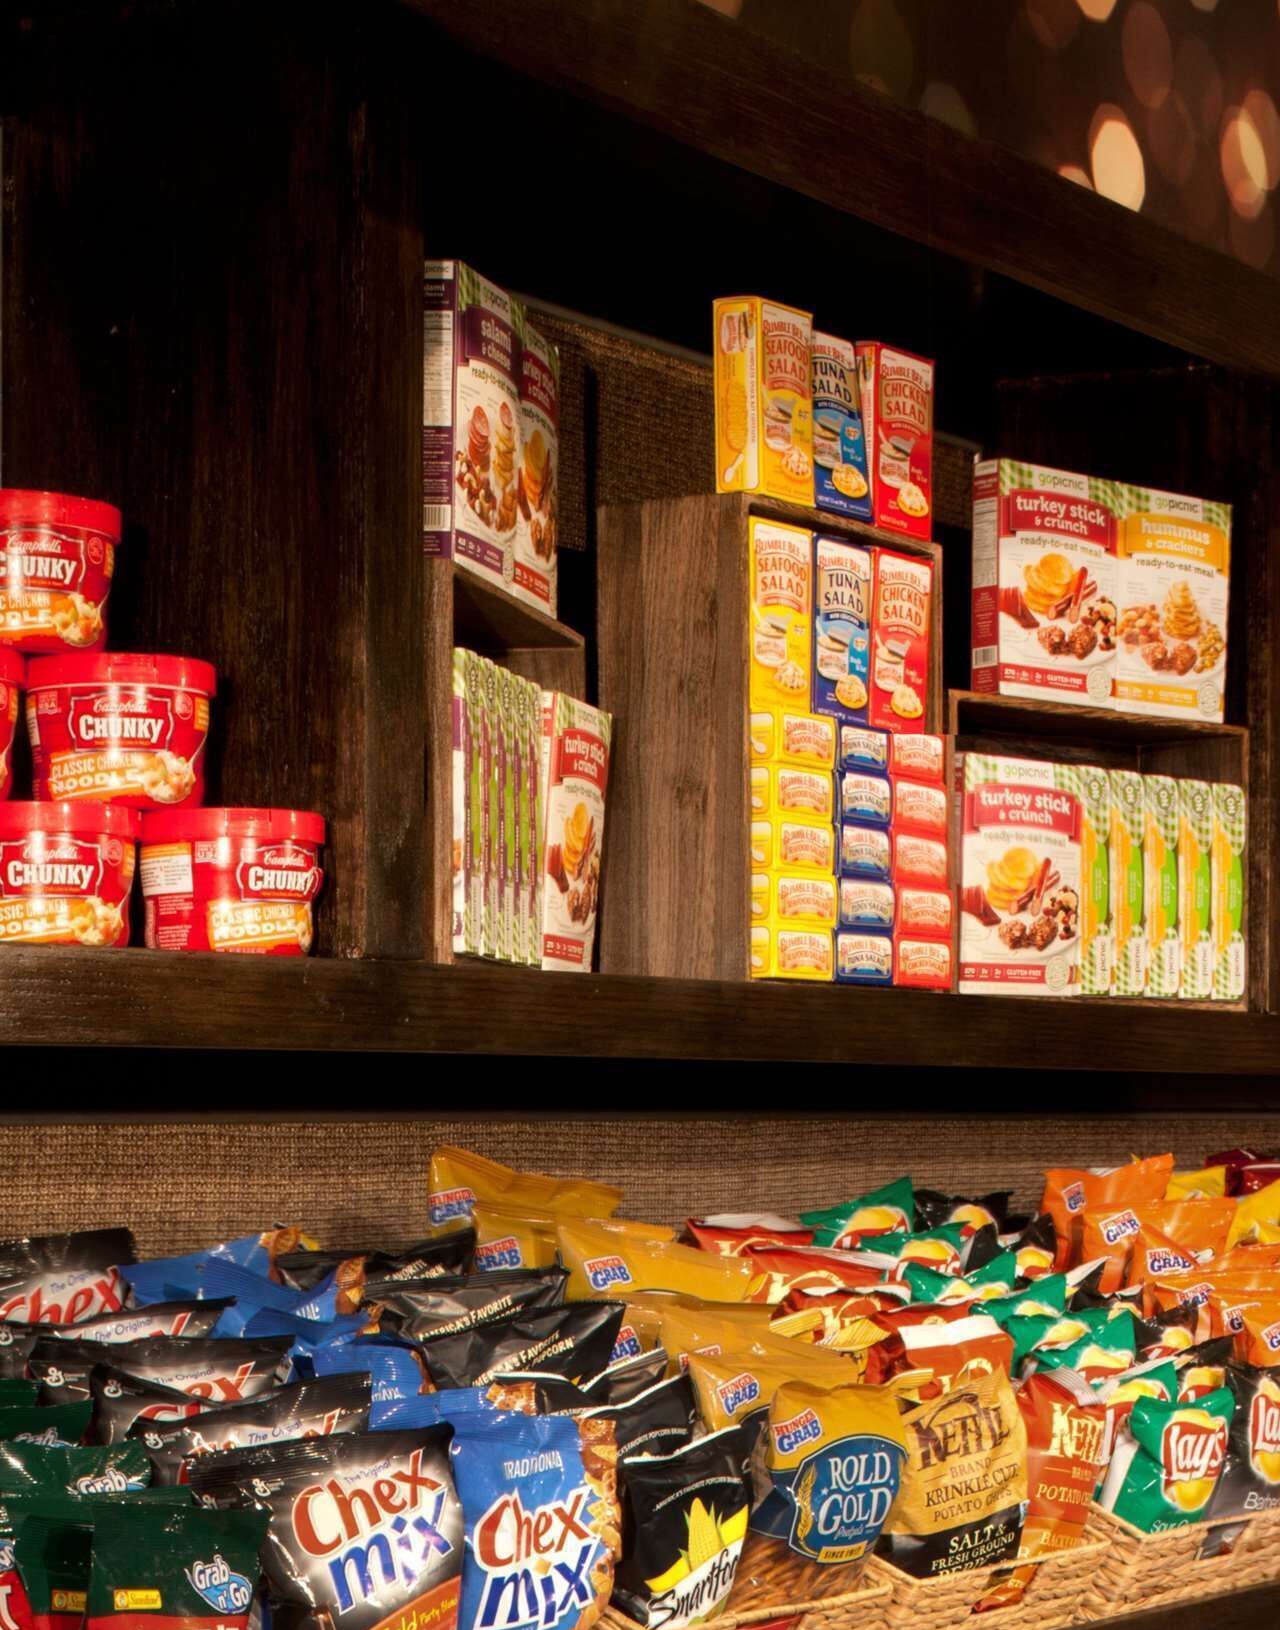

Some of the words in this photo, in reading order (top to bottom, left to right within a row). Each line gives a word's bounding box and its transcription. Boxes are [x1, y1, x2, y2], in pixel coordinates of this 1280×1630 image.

[766, 339, 809, 364] SEAFOOD
[768, 359, 807, 383] SALAD
[813, 360, 847, 383] TUNA
[811, 379, 852, 403] SALAD
[884, 382, 929, 409] CHICKEN
[886, 401, 925, 424] SALAD
[1038, 472, 1086, 492] gopicnic
[1015, 494, 1068, 518] turkey
[1069, 505, 1107, 528] stick
[1153, 496, 1200, 515] gopicnic
[1043, 516, 1089, 536] crunch
[1141, 518, 1211, 546] hummus
[1019, 535, 1079, 554] ready-to-eat
[1154, 539, 1206, 558] crackers
[757, 557, 807, 582] SEAFOOD
[760, 574, 805, 599] SALAD
[827, 572, 861, 594] TUNA
[823, 591, 864, 615] SALAD
[881, 587, 926, 612] CHICKEN
[882, 604, 922, 627] SALAD
[78, 715, 165, 744] CHUNKY
[51, 757, 96, 782] CLASSIC
[1003, 765, 1050, 780] gopicnic
[980, 789, 1033, 809] turkey
[1034, 794, 1071, 815] stick
[1008, 807, 1054, 825] crunch
[6, 861, 95, 887] CHUNKY
[587, 1257, 623, 1274] HUNGER
[591, 1265, 632, 1291] GRAB
[469, 1295, 513, 1325] FAVORITE
[719, 1374, 756, 1398] HUNGER
[723, 1382, 760, 1416] GRAB
[773, 1410, 817, 1436] HUNGER
[777, 1420, 823, 1455] GRAB
[1169, 1425, 1225, 1481] Lay's
[828, 1451, 893, 1491] ROLD
[949, 1455, 993, 1480] BRAND
[925, 1472, 989, 1508] KRINKLE
[989, 1462, 1019, 1487] CUT
[291, 1447, 447, 1557] Chex
[816, 1488, 893, 1536] GOLD
[933, 1497, 985, 1522] POTATO
[473, 1486, 593, 1570] Chex
[948, 1525, 993, 1554] SALT
[327, 1489, 455, 1616] mix
[930, 1546, 972, 1571] FRESH
[971, 1533, 1016, 1560] GROUND
[191, 1554, 231, 1591] Grab
[229, 1580, 250, 1608] Go
